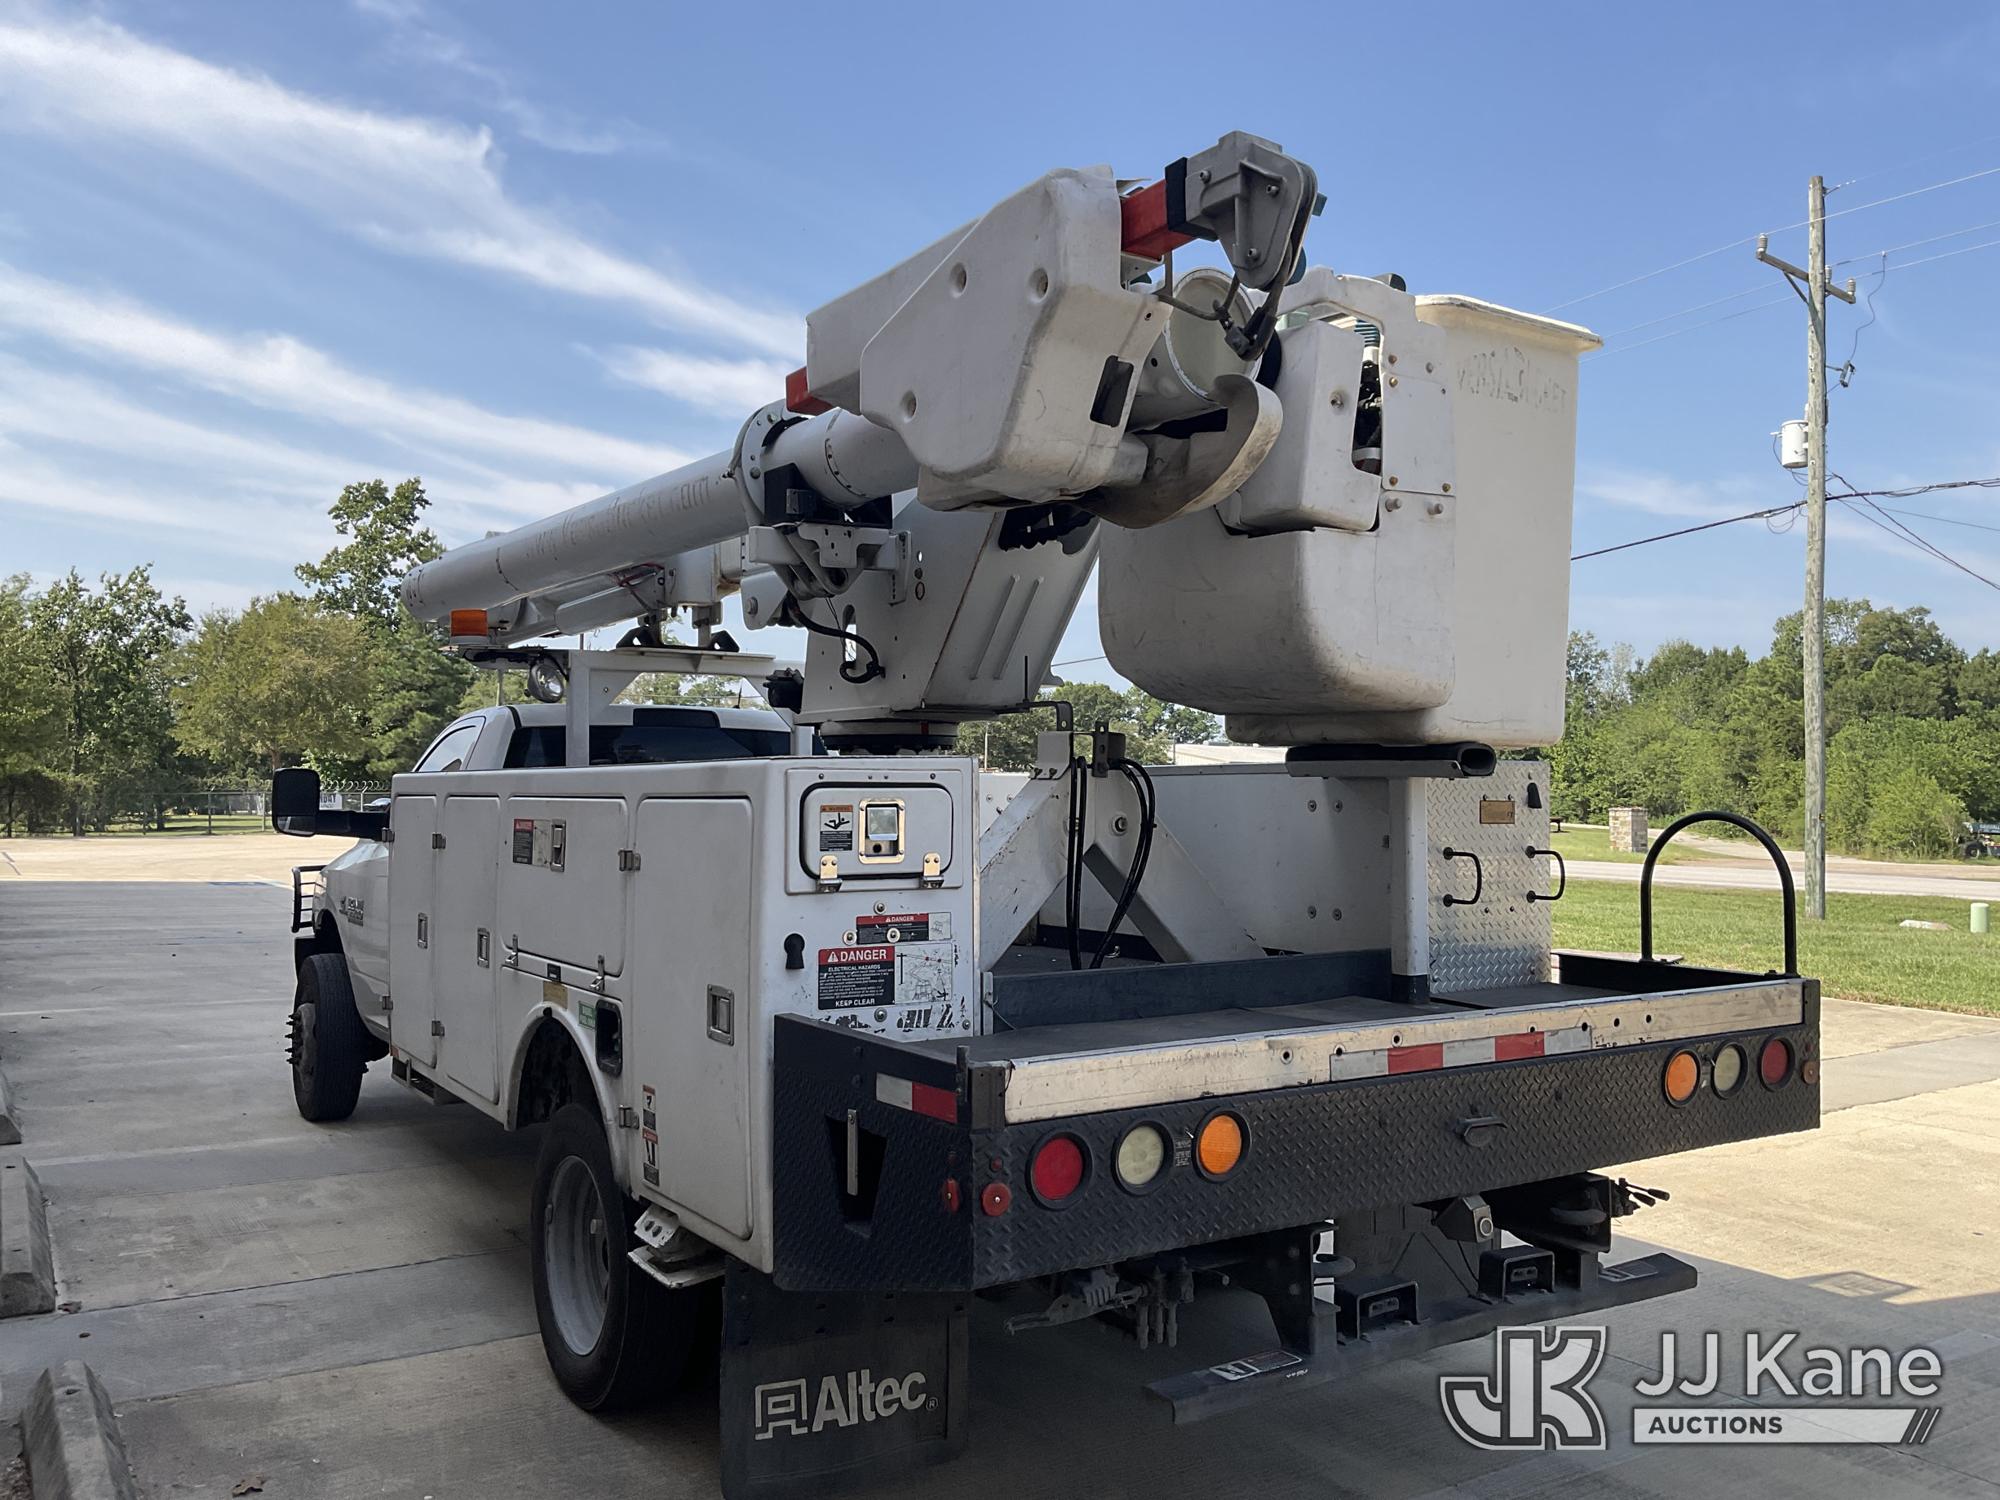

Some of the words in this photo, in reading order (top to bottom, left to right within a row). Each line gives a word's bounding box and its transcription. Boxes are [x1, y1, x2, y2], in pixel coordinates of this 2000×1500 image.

[840, 949, 887, 962] DANGER
[853, 998, 875, 1006] CLEAR
[811, 1368, 927, 1433] Altec
